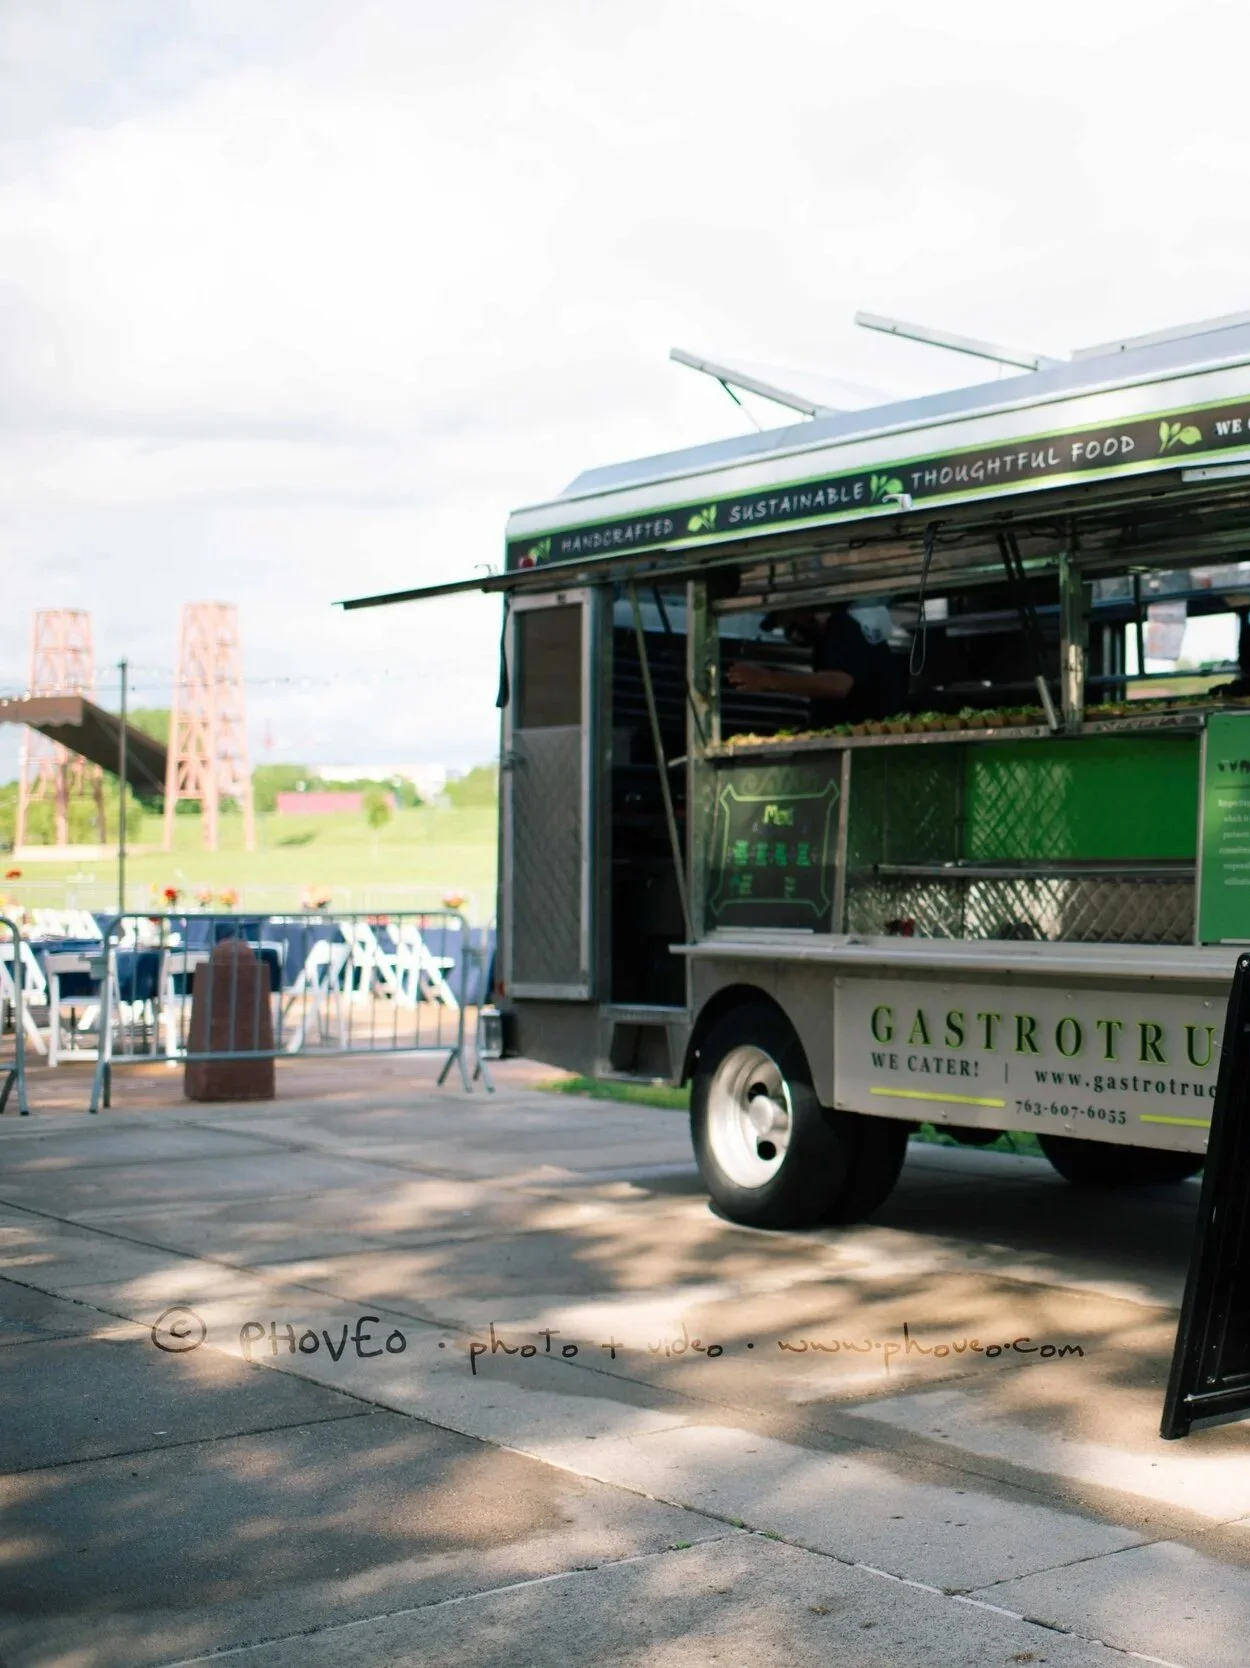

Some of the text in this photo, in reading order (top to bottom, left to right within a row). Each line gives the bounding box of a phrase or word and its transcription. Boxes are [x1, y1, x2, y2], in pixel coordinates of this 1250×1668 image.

[561, 518, 673, 554] HANDCRAFTED
[728, 481, 865, 523] SUSTAINABLE
[911, 447, 1061, 488] THOUGHTFUL
[1071, 435, 1136, 462] FOOD
[1214, 418, 1242, 436] WE
[871, 1052, 899, 1071] WE
[907, 1055, 980, 1078] CATER!
[1015, 1100, 1127, 1125] 763-607-6055
